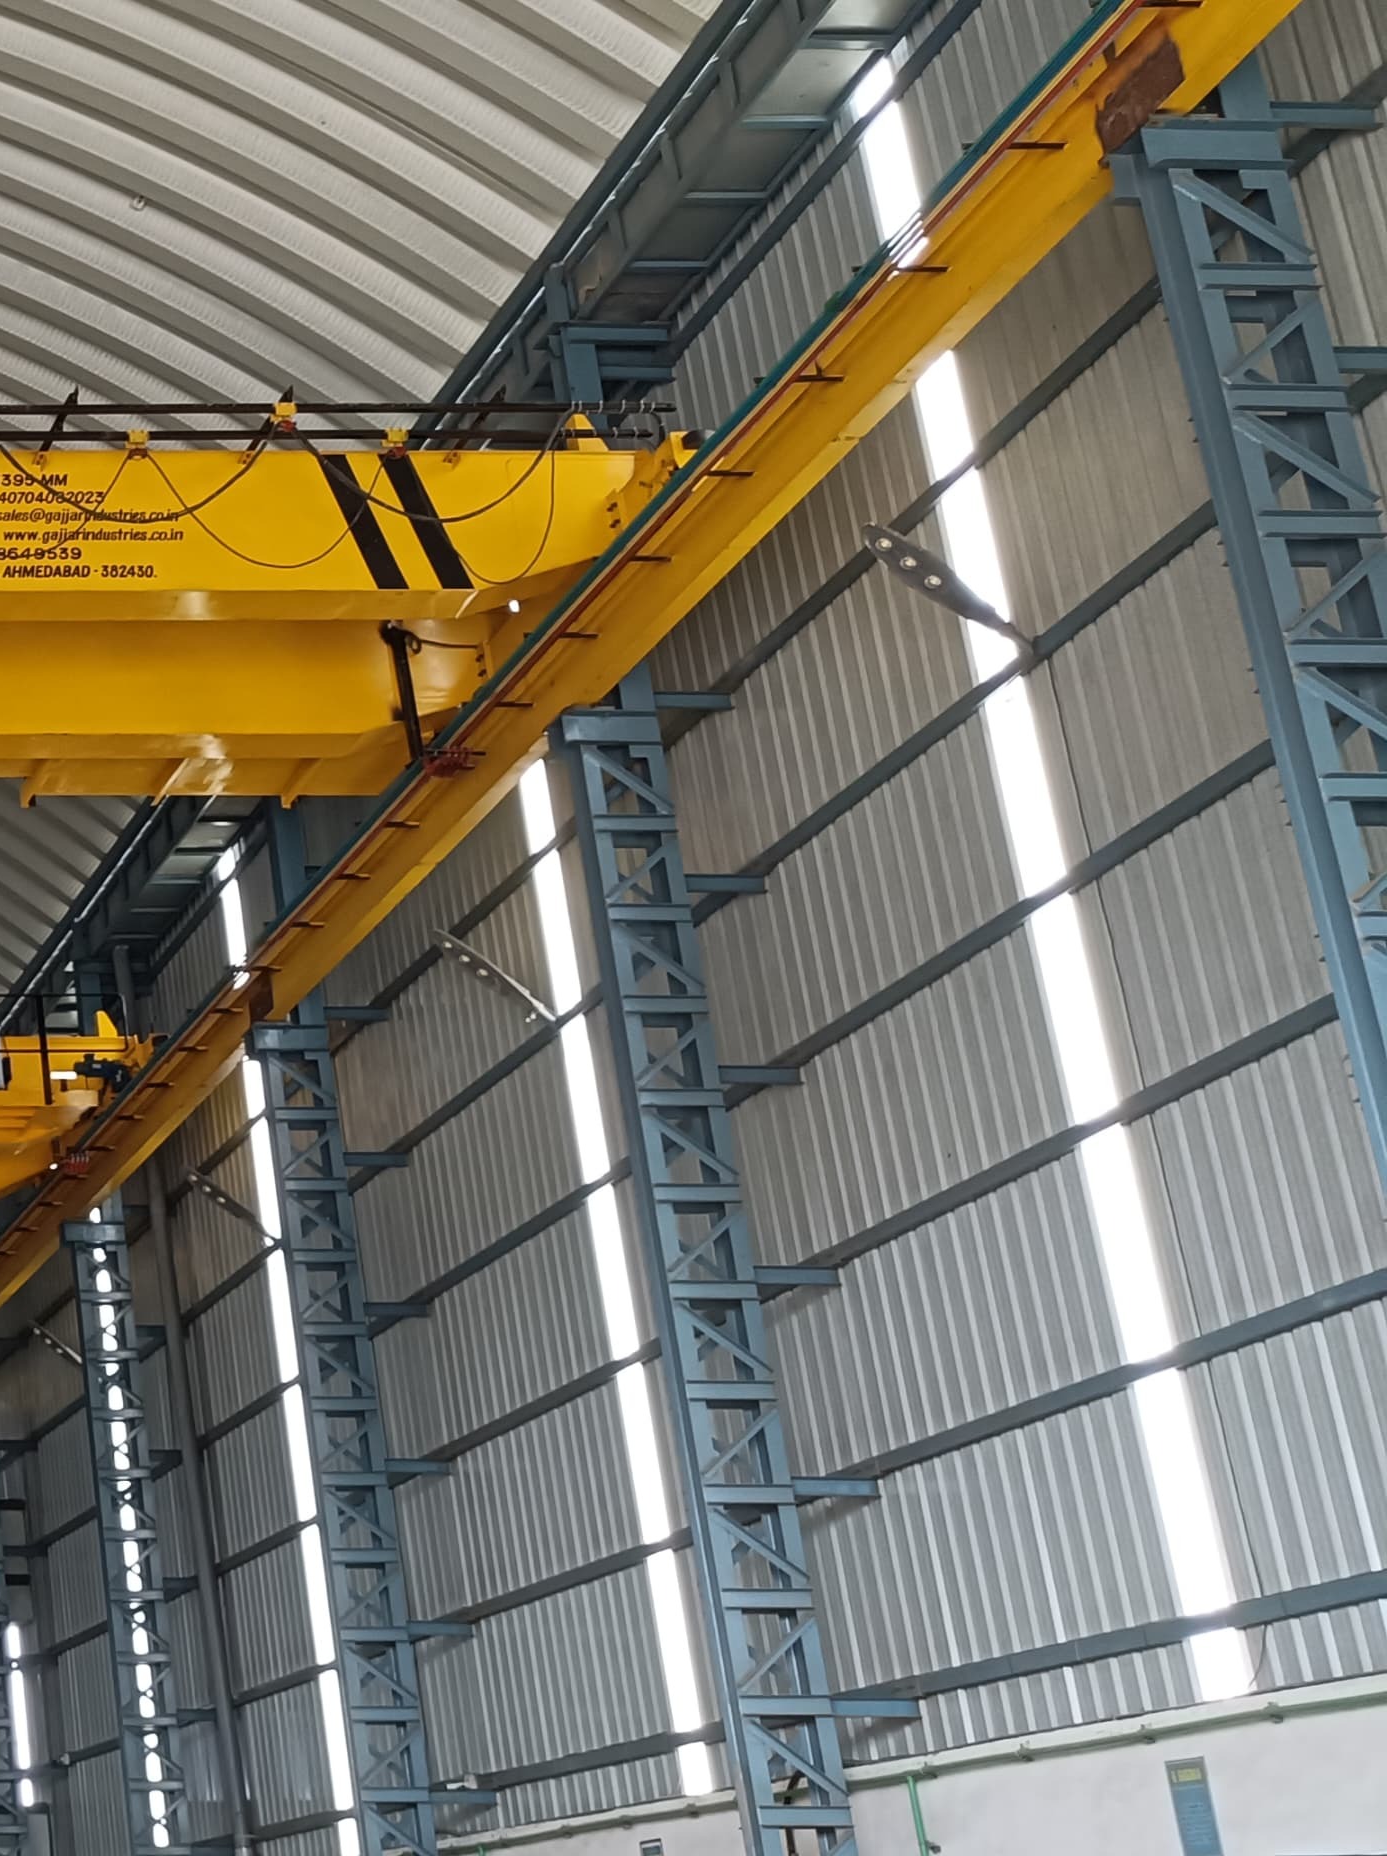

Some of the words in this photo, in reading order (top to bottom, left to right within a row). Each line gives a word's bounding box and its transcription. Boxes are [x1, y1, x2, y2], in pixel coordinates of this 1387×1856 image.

[41, 474, 67, 486] MM
[3, 565, 90, 579] AHMEDABAD
[101, 565, 157, 579] 382430.
